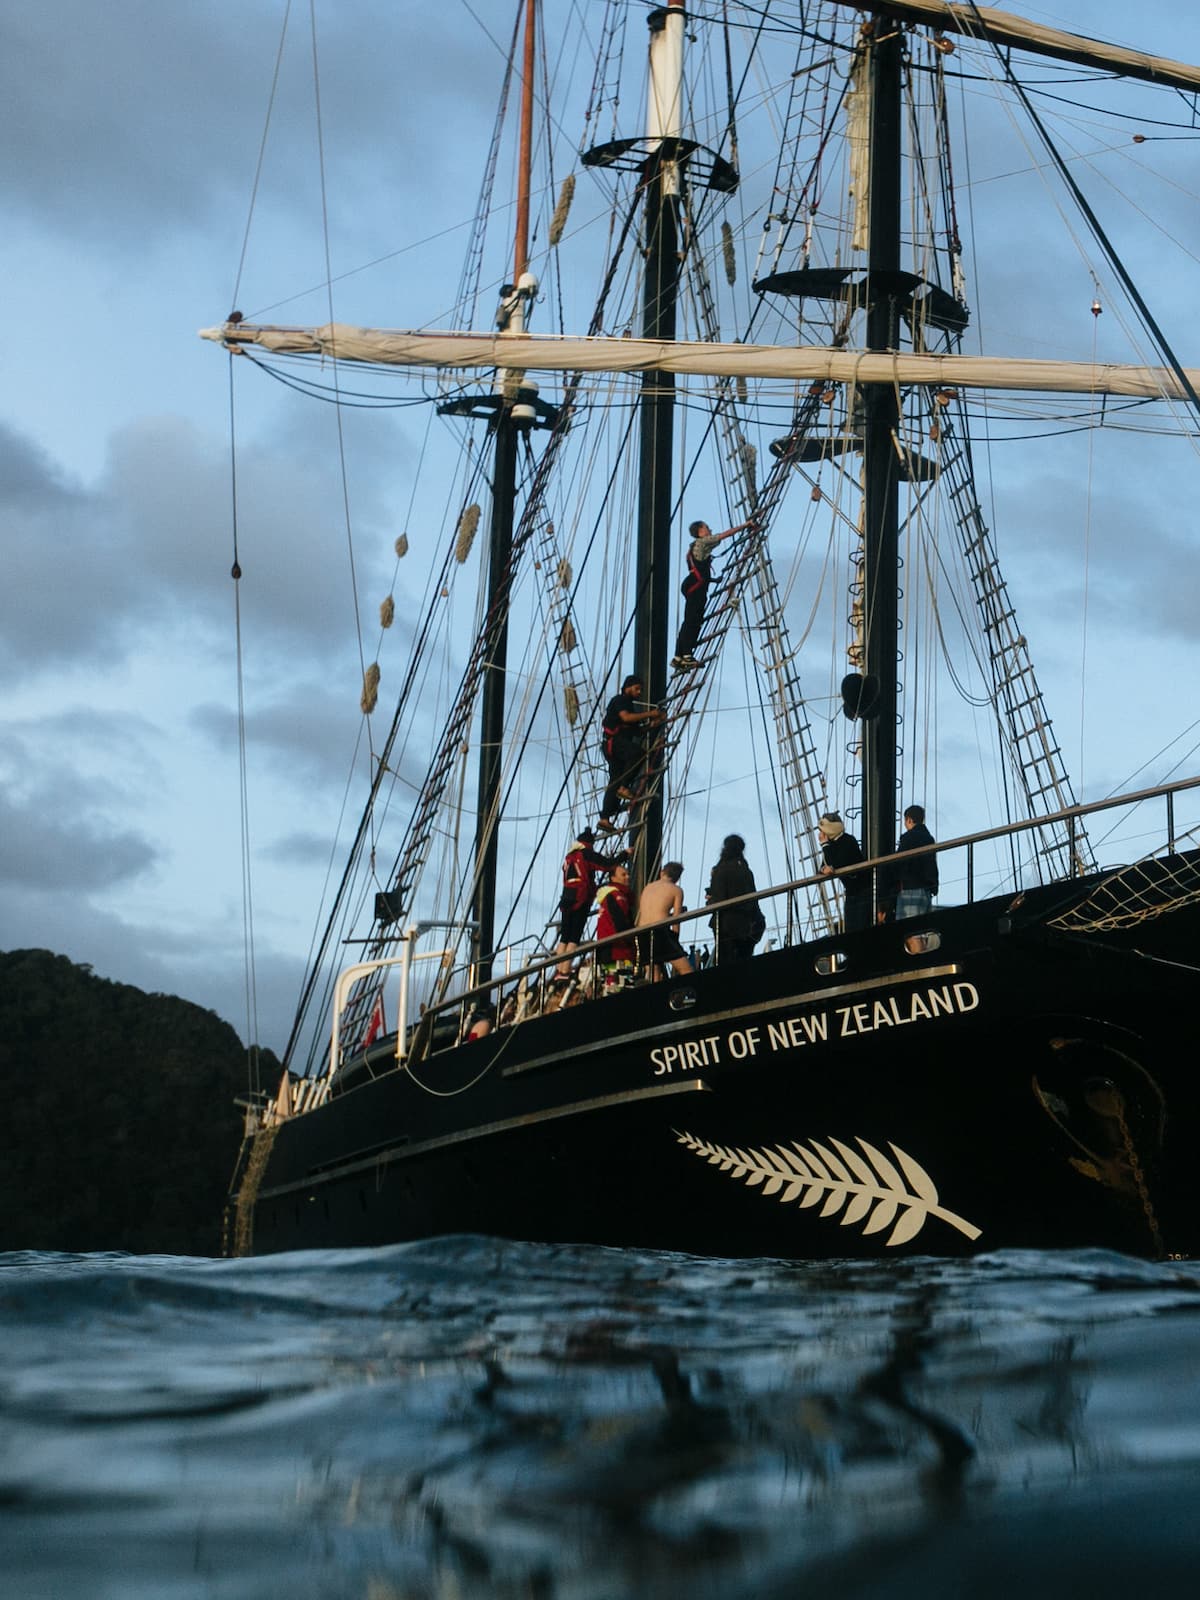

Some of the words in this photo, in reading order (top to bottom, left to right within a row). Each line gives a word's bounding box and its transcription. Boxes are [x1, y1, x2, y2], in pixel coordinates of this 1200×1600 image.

[650, 1036, 720, 1076] SPIRIT
[728, 1027, 761, 1060] OF
[767, 1013, 828, 1051] NEW
[836, 982, 980, 1038] ZEALAND
